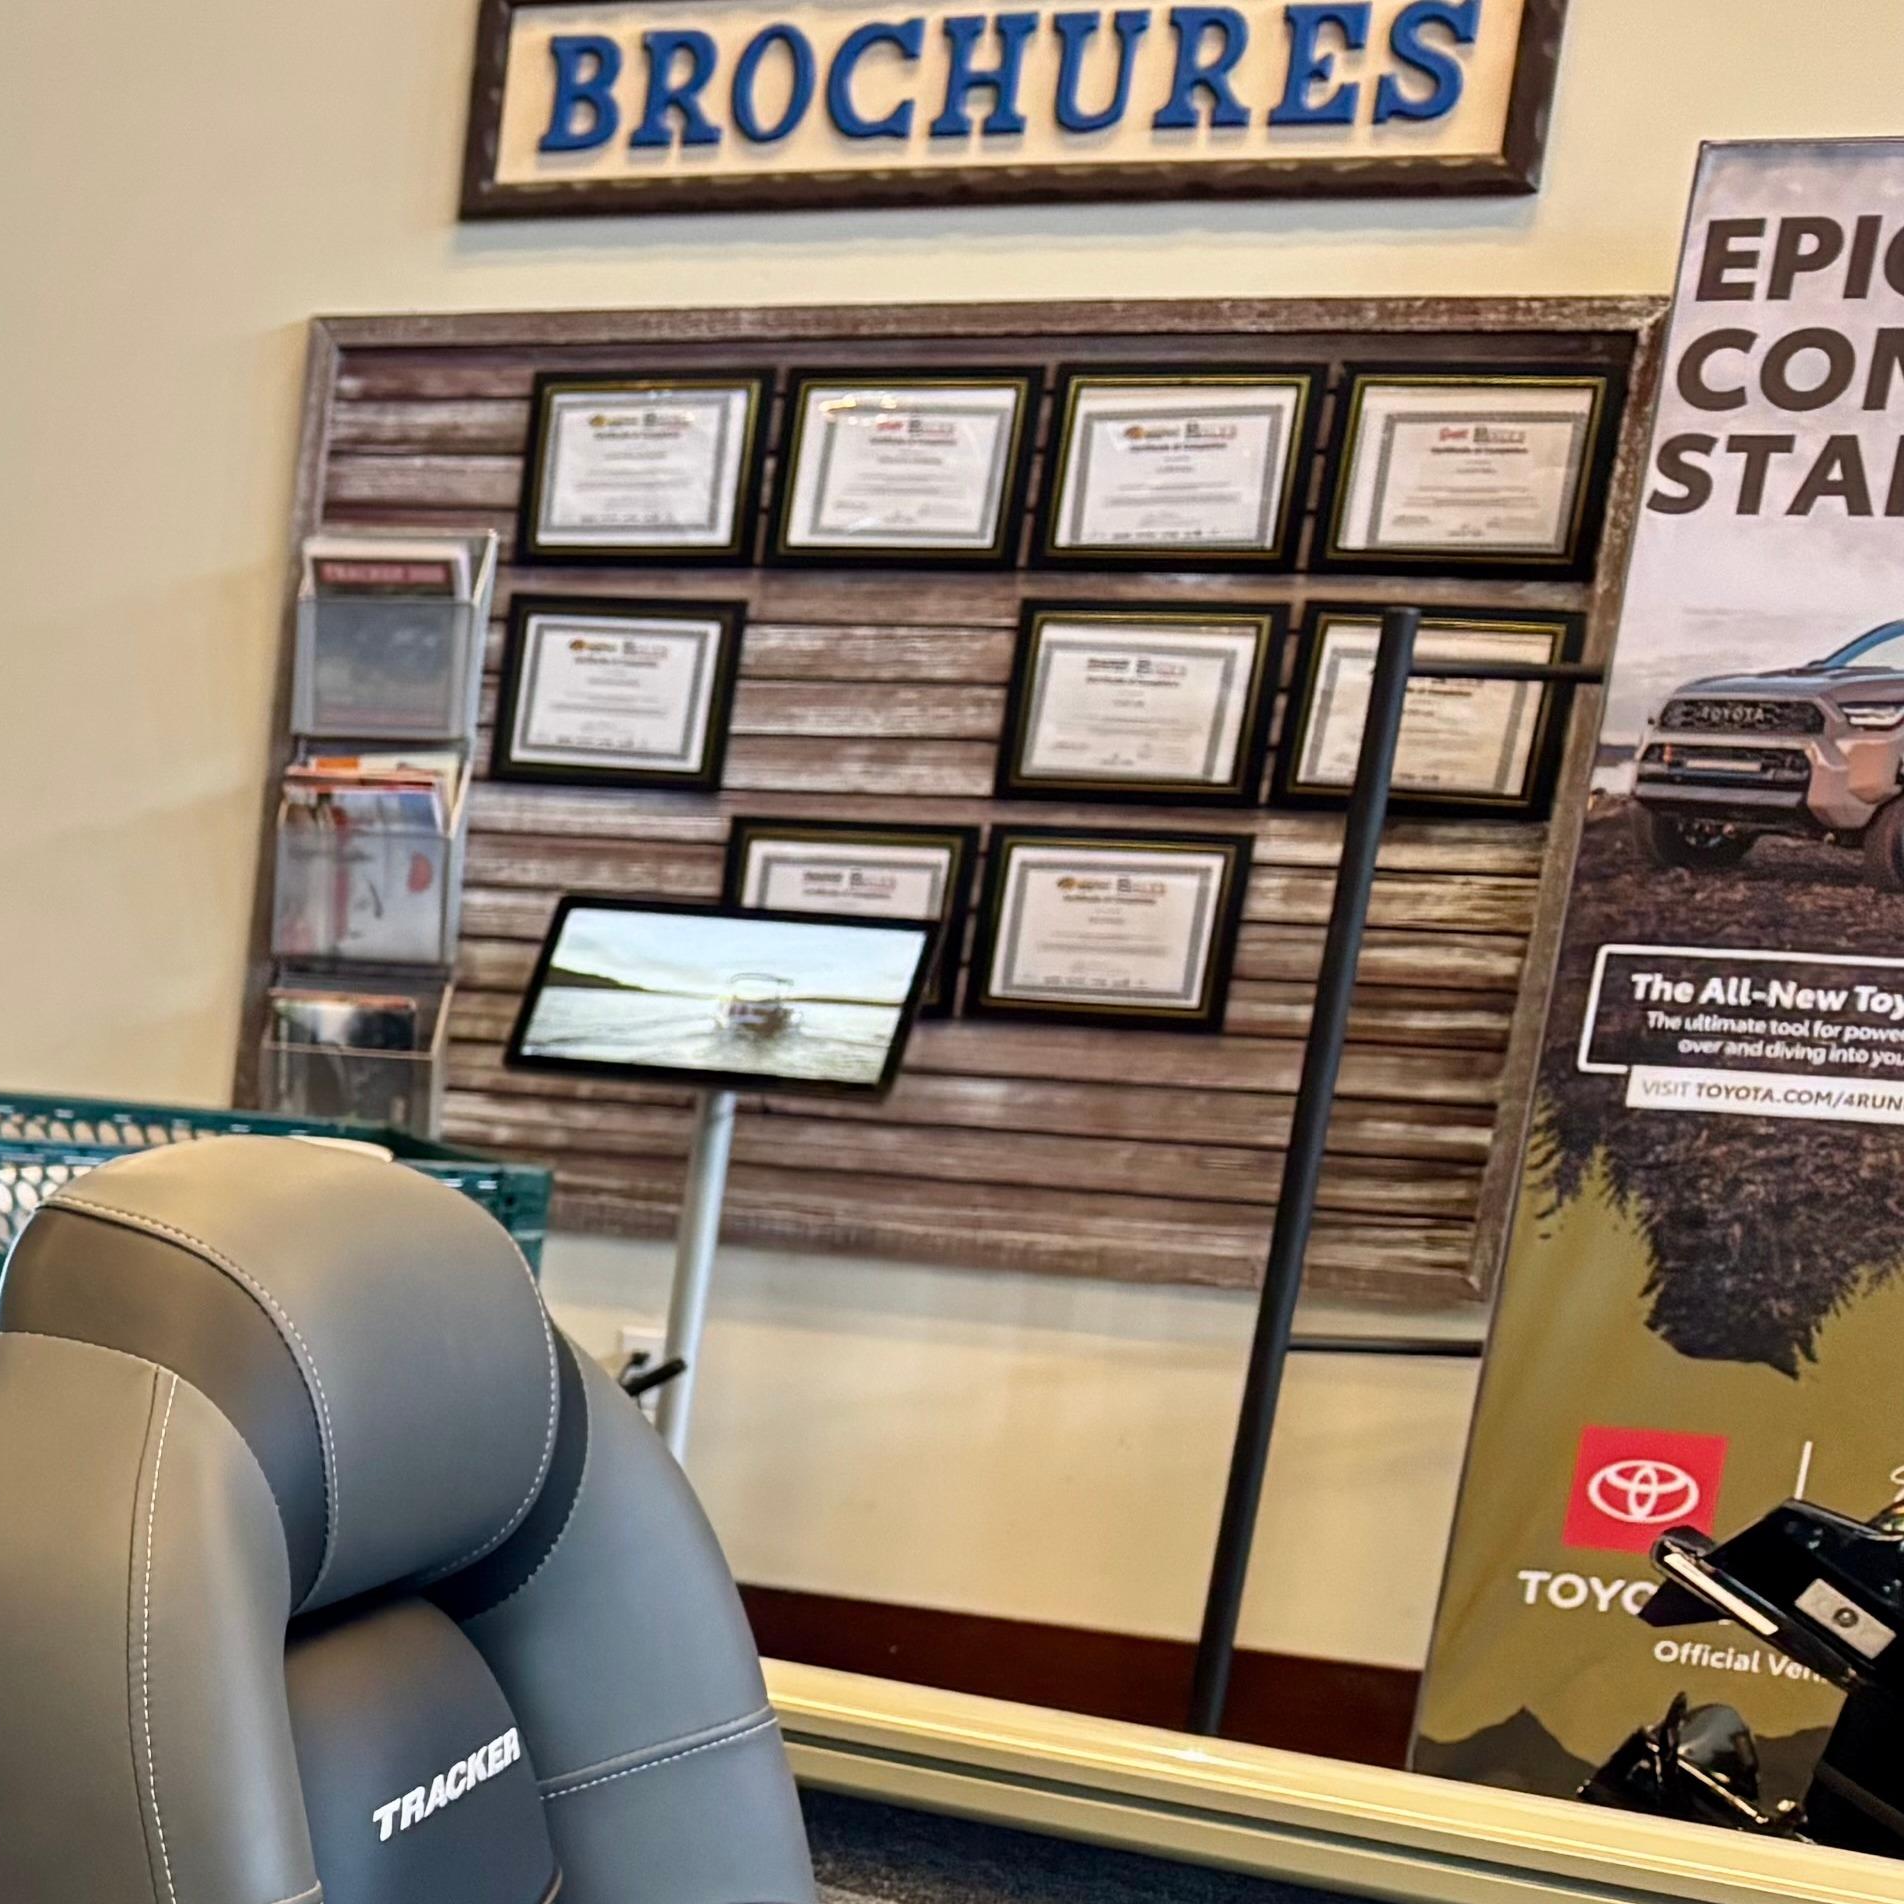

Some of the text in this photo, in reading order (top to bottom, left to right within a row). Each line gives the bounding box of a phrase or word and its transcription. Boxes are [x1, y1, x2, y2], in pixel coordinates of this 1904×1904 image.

[537, 0, 1476, 153] BROCHURES
[1695, 215, 1904, 302] EPI
[1646, 433, 1904, 517] STA
[1631, 972, 1695, 1003] The
[1698, 977, 1848, 1011] All-New
[1647, 1010, 1682, 1031] The
[1684, 1013, 1768, 1034] ultimate
[1770, 1019, 1810, 1037] tool
[1812, 1020, 1842, 1039] for
[1677, 1038, 1726, 1054] over
[1724, 1040, 1764, 1057] and
[1764, 1041, 1827, 1065] diving
[1828, 1043, 1869, 1063] into
[1641, 1080, 1692, 1097] VISIT
[1518, 1570, 1658, 1616] TOYO
[1653, 1640, 1760, 1674] Official
[372, 1727, 521, 1842] TRACKER
